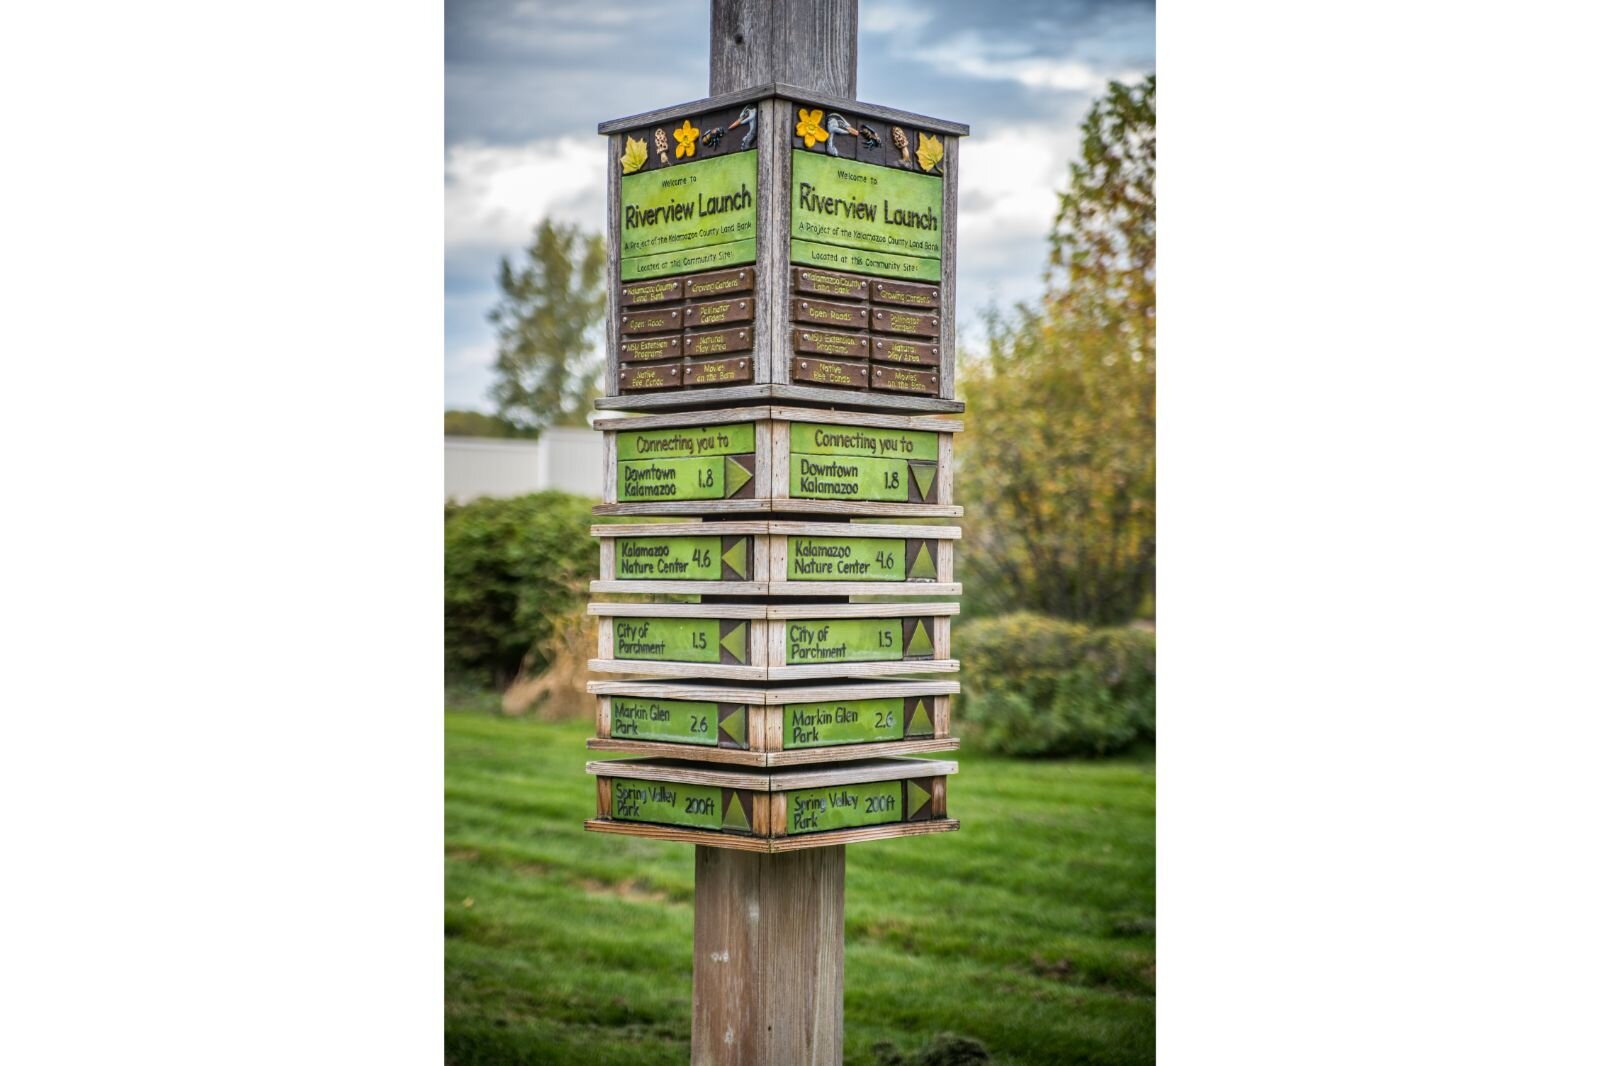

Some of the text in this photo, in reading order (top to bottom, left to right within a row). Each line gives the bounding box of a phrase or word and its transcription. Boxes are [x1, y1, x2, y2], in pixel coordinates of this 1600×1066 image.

[662, 177, 686, 188] Welcome
[838, 170, 866, 183] Welcome
[626, 183, 752, 230] Riverview Launch
[800, 182, 938, 231] Riverview Launch
[630, 241, 650, 250] Project
[668, 232, 698, 242] Kalamazoo
[699, 228, 720, 238] County
[720, 224, 734, 234] Land
[737, 221, 752, 231] Bank
[799, 222, 804, 232] A
[806, 222, 830, 234] Project
[841, 228, 852, 237] the
[854, 230, 886, 242] Kalamazoo
[888, 236, 908, 248] County
[910, 239, 923, 248] Land
[924, 242, 938, 252] Bank
[637, 263, 660, 272] Located
[683, 253, 716, 266] Community
[812, 251, 838, 262] Located
[852, 256, 862, 265] this
[866, 258, 900, 270] Community
[807, 272, 861, 290] Kalamazoo County
[809, 308, 852, 320] Open Roads
[636, 432, 728, 454] Connecting you to
[815, 429, 914, 454] Connecting you to
[624, 464, 676, 481] Downtown
[800, 459, 858, 478] Downtown
[698, 468, 714, 488] 1.8
[800, 478, 858, 494] Kalamazoo
[884, 472, 900, 489] 1.8
[624, 484, 676, 496] Kalamazoo
[622, 542, 670, 557] Kalamazoo
[692, 548, 712, 568] 4.6
[796, 540, 851, 558] Kalamazoo
[622, 558, 688, 574] Nature Center
[794, 558, 870, 574] Nature Center
[876, 551, 894, 569] 4.6
[617, 622, 650, 640] City of
[790, 624, 829, 645] City of
[878, 630, 892, 648] 1.5
[618, 639, 666, 654] Parchment
[692, 632, 706, 650] 1.5
[792, 643, 846, 660] Parchment
[614, 702, 670, 722] Markin Glen
[792, 707, 858, 726] Markin Glen
[874, 712, 894, 728] 2.6
[616, 719, 638, 735] Park
[690, 715, 708, 733] 2.6
[793, 726, 818, 744] Park
[616, 783, 676, 808] Spring Valley
[794, 792, 858, 815] Spring Valley
[865, 795, 895, 814] 200ft
[618, 800, 639, 816] Park
[685, 797, 714, 816] 200ft
[794, 813, 818, 830] Park
